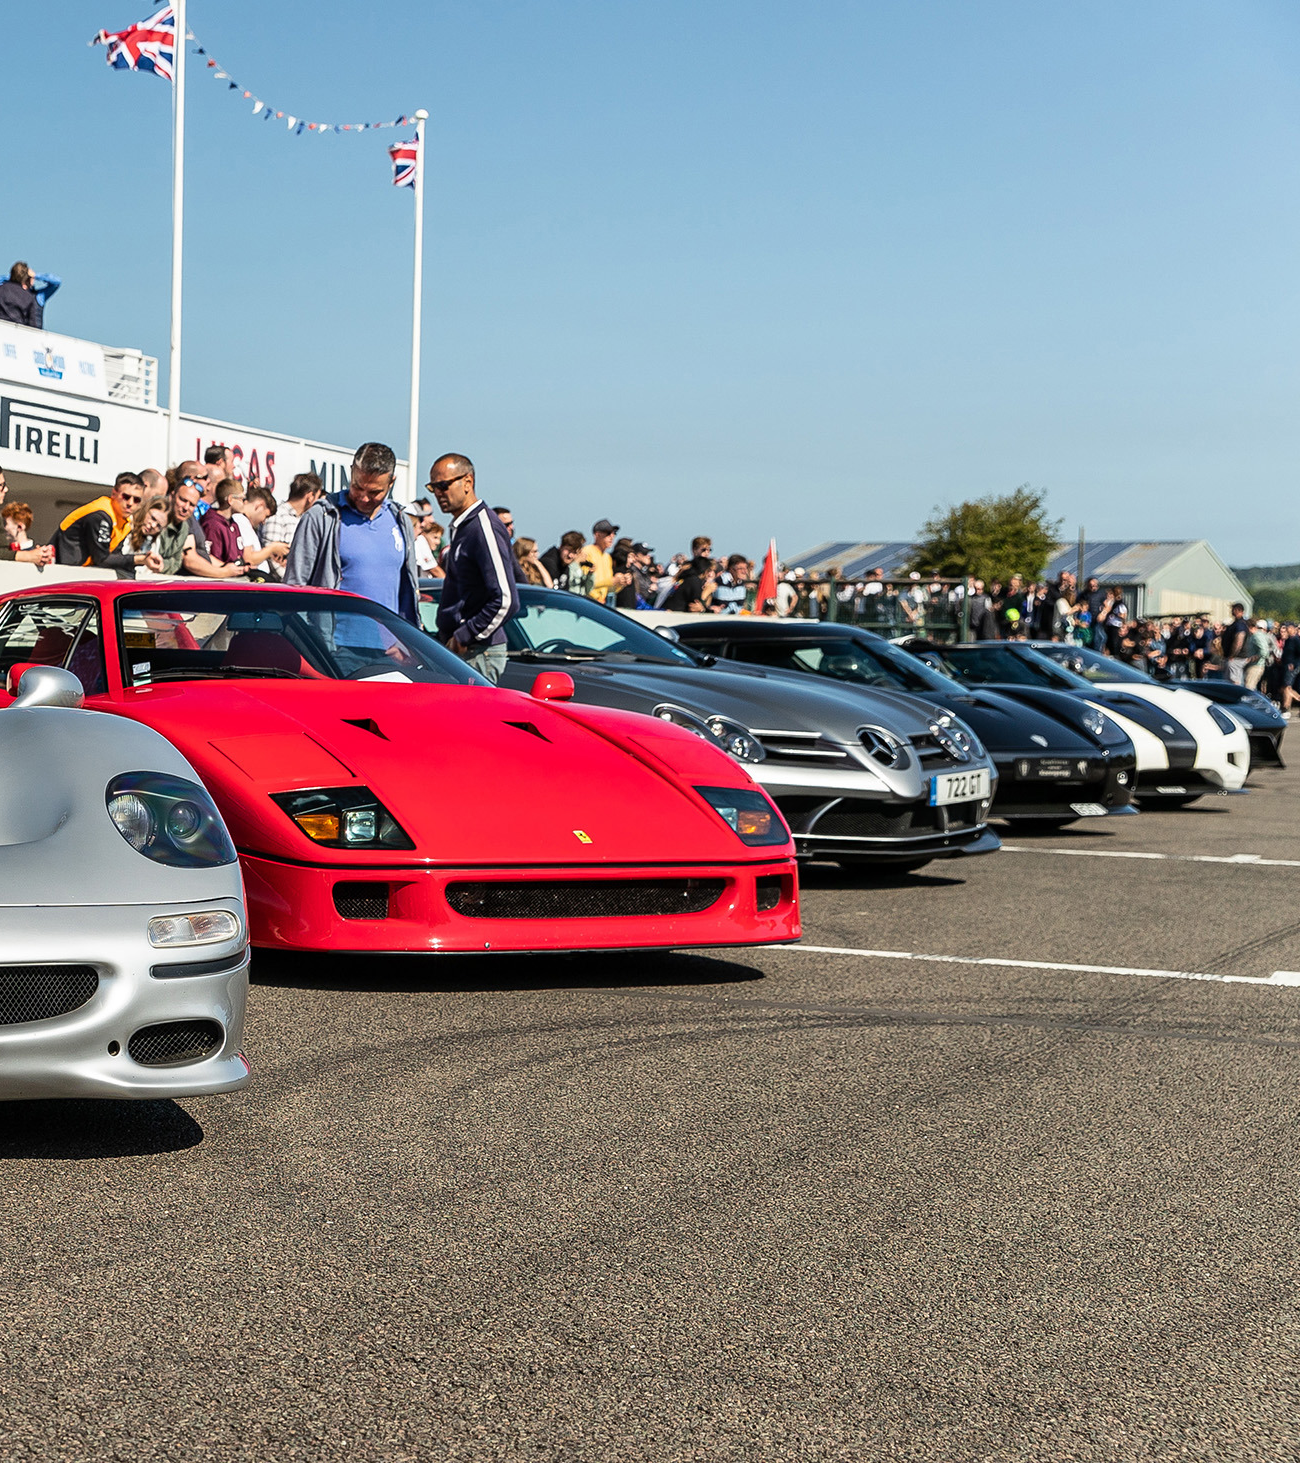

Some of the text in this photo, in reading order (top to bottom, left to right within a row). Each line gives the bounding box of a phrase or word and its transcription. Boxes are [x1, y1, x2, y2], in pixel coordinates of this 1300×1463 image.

[0, 396, 101, 464] PIRELLI
[196, 438, 276, 493] LCAS
[947, 774, 981, 799] 722 GT
